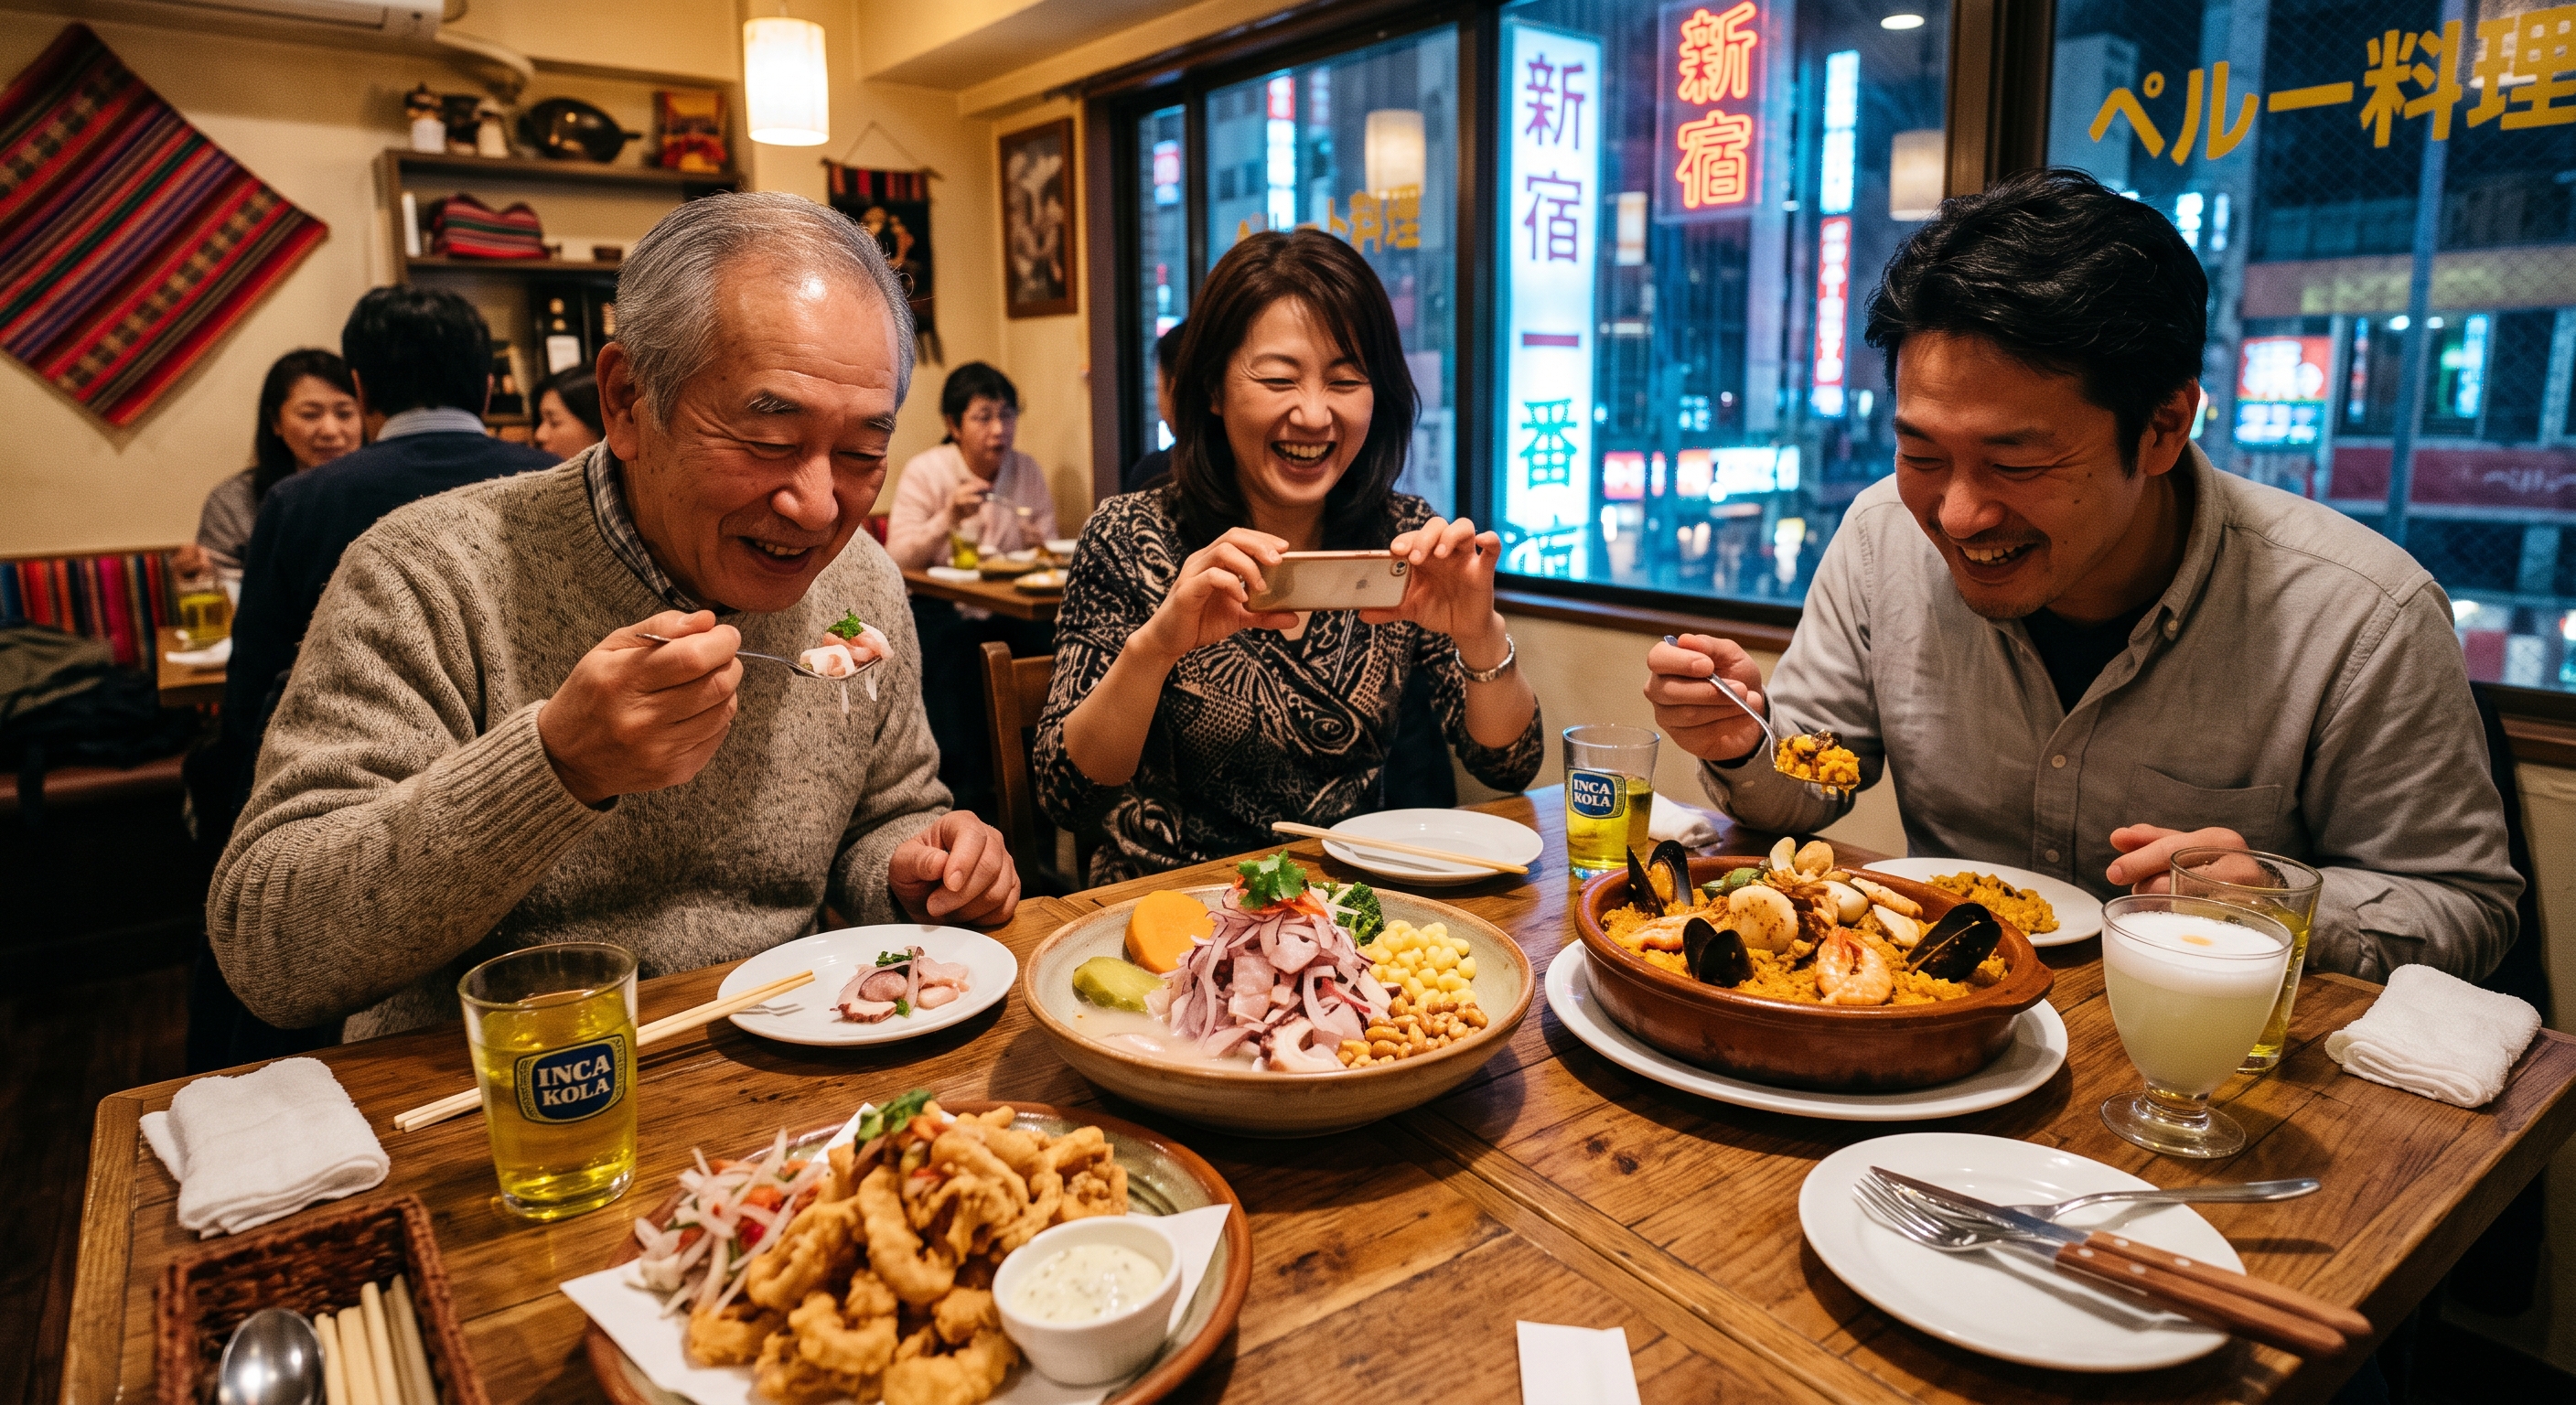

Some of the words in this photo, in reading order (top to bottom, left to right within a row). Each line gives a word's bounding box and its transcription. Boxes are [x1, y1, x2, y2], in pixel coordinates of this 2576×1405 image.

[2088, 4, 2576, 166] ペルー料理
[1675, 1, 1758, 209] 新宿
[1573, 778, 1612, 796] INCA
[1573, 792, 1612, 808] KOLA
[537, 1054, 612, 1088] INCA
[542, 1078, 611, 1107] KOLA
